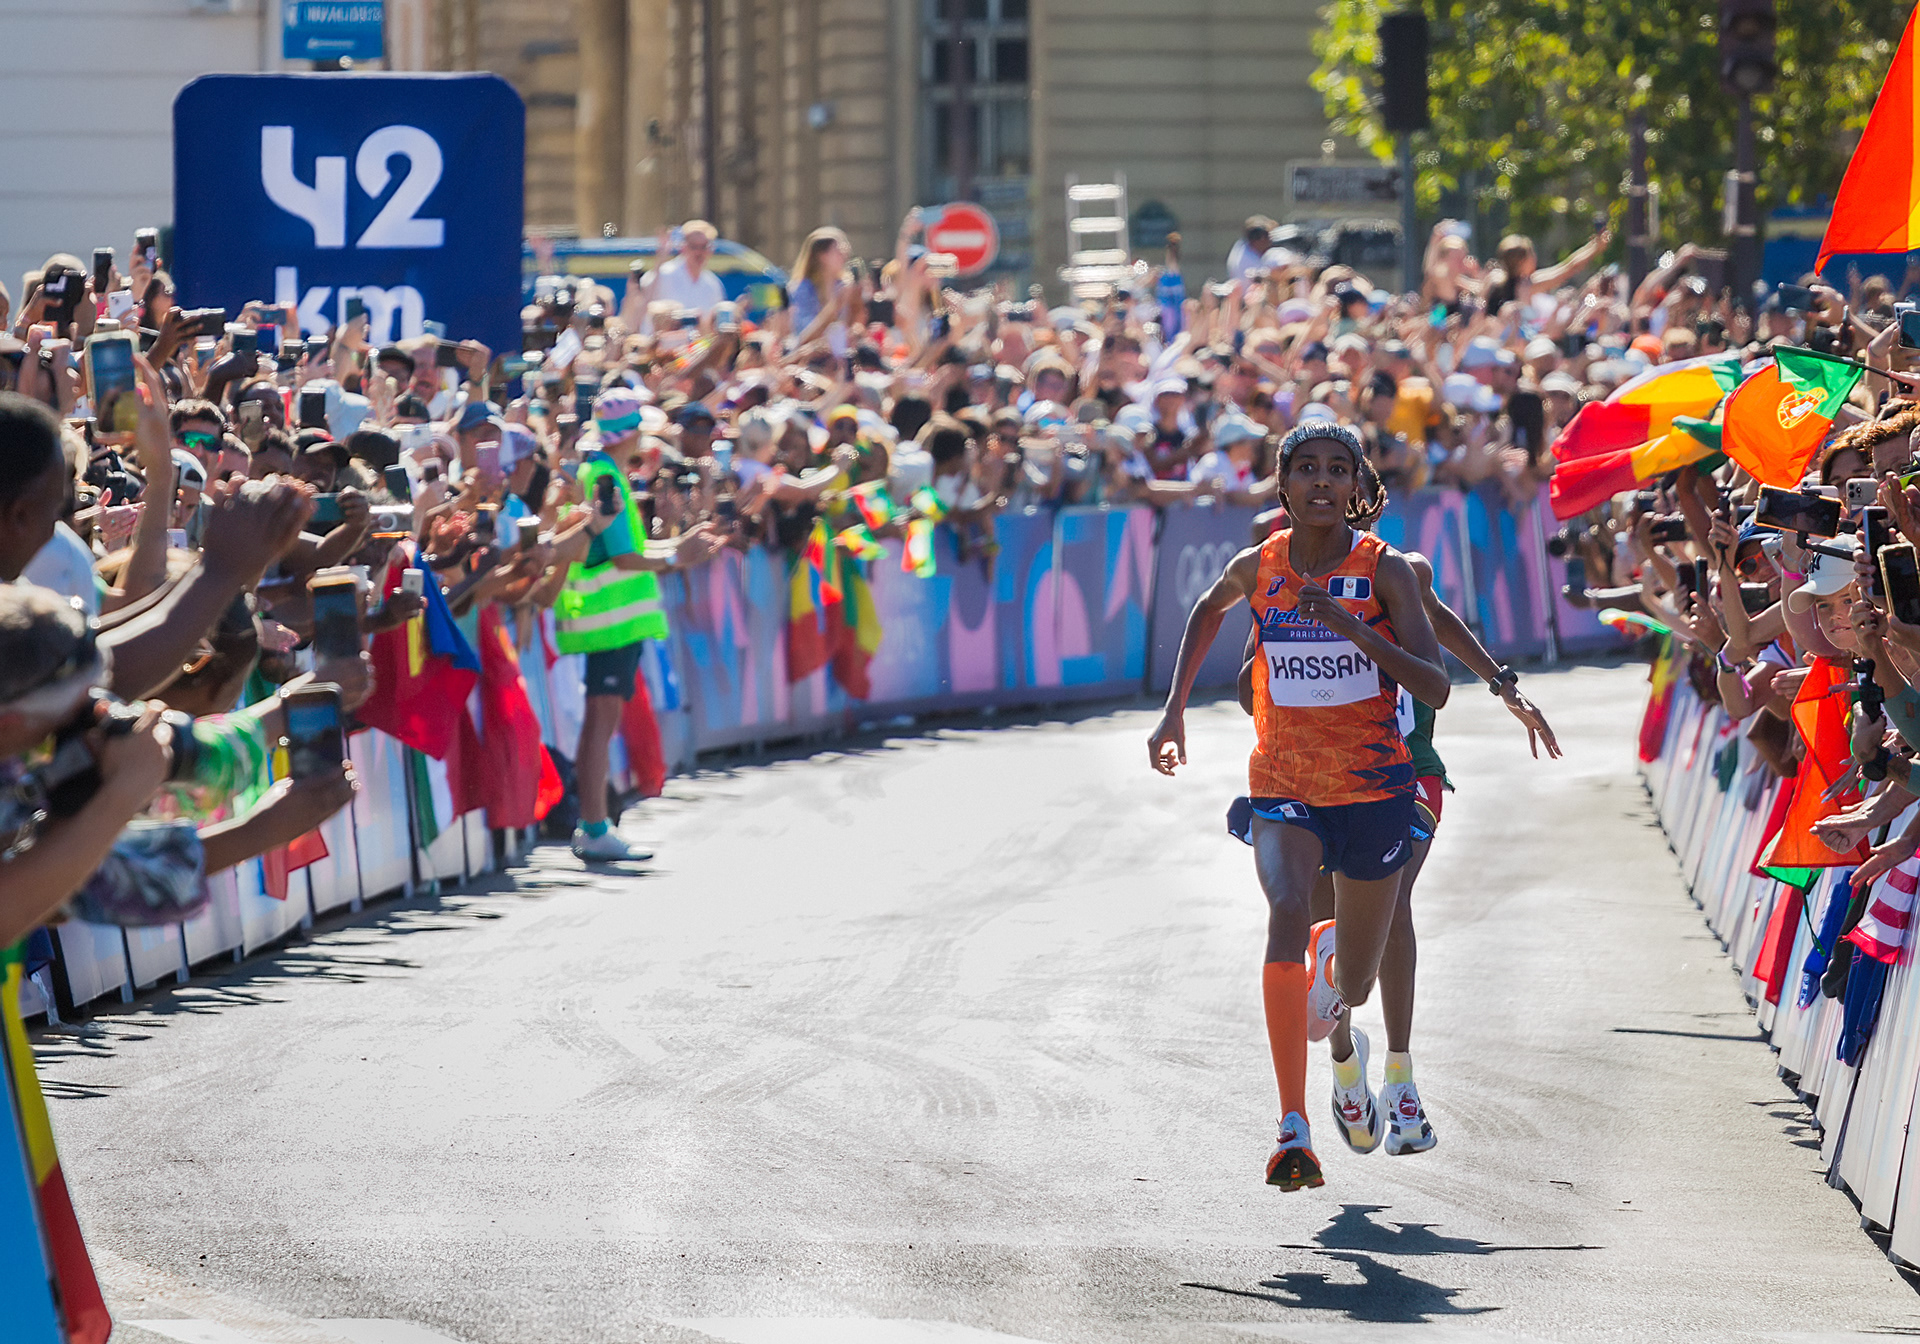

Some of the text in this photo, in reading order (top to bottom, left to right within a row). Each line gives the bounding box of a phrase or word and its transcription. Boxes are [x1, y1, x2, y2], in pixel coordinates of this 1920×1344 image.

[261, 125, 444, 247] 42
[275, 266, 425, 346] km
[1290, 630, 1316, 638] PARIS
[1271, 652, 1372, 680] HASSAN
